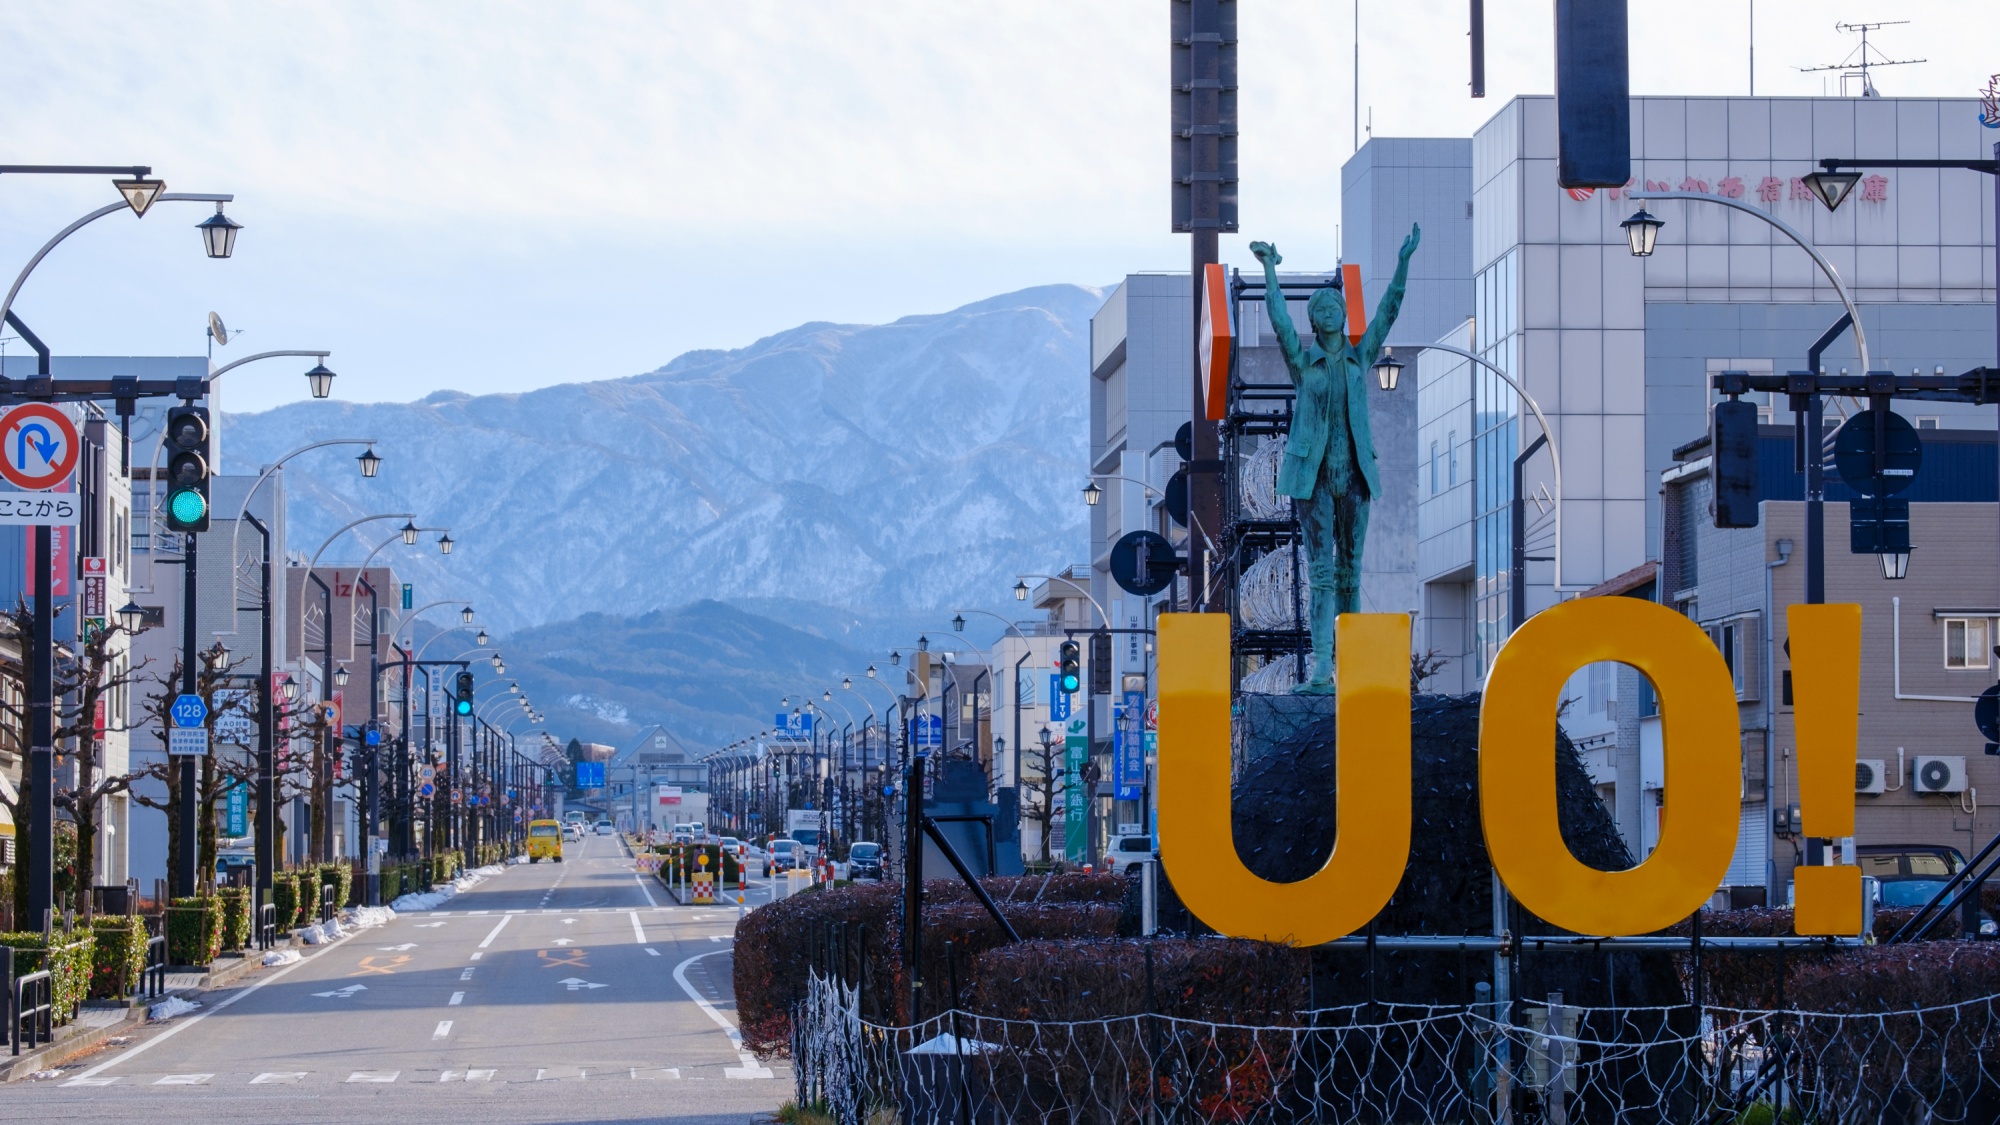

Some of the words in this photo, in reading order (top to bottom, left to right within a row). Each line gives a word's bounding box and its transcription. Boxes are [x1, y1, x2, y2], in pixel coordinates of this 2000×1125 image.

[0, 500, 74, 518] ここから
[177, 704, 202, 718] 128
[1060, 705, 1067, 718] TV
[421, 769, 433, 777] 40
[1157, 596, 1862, 947] UO!
